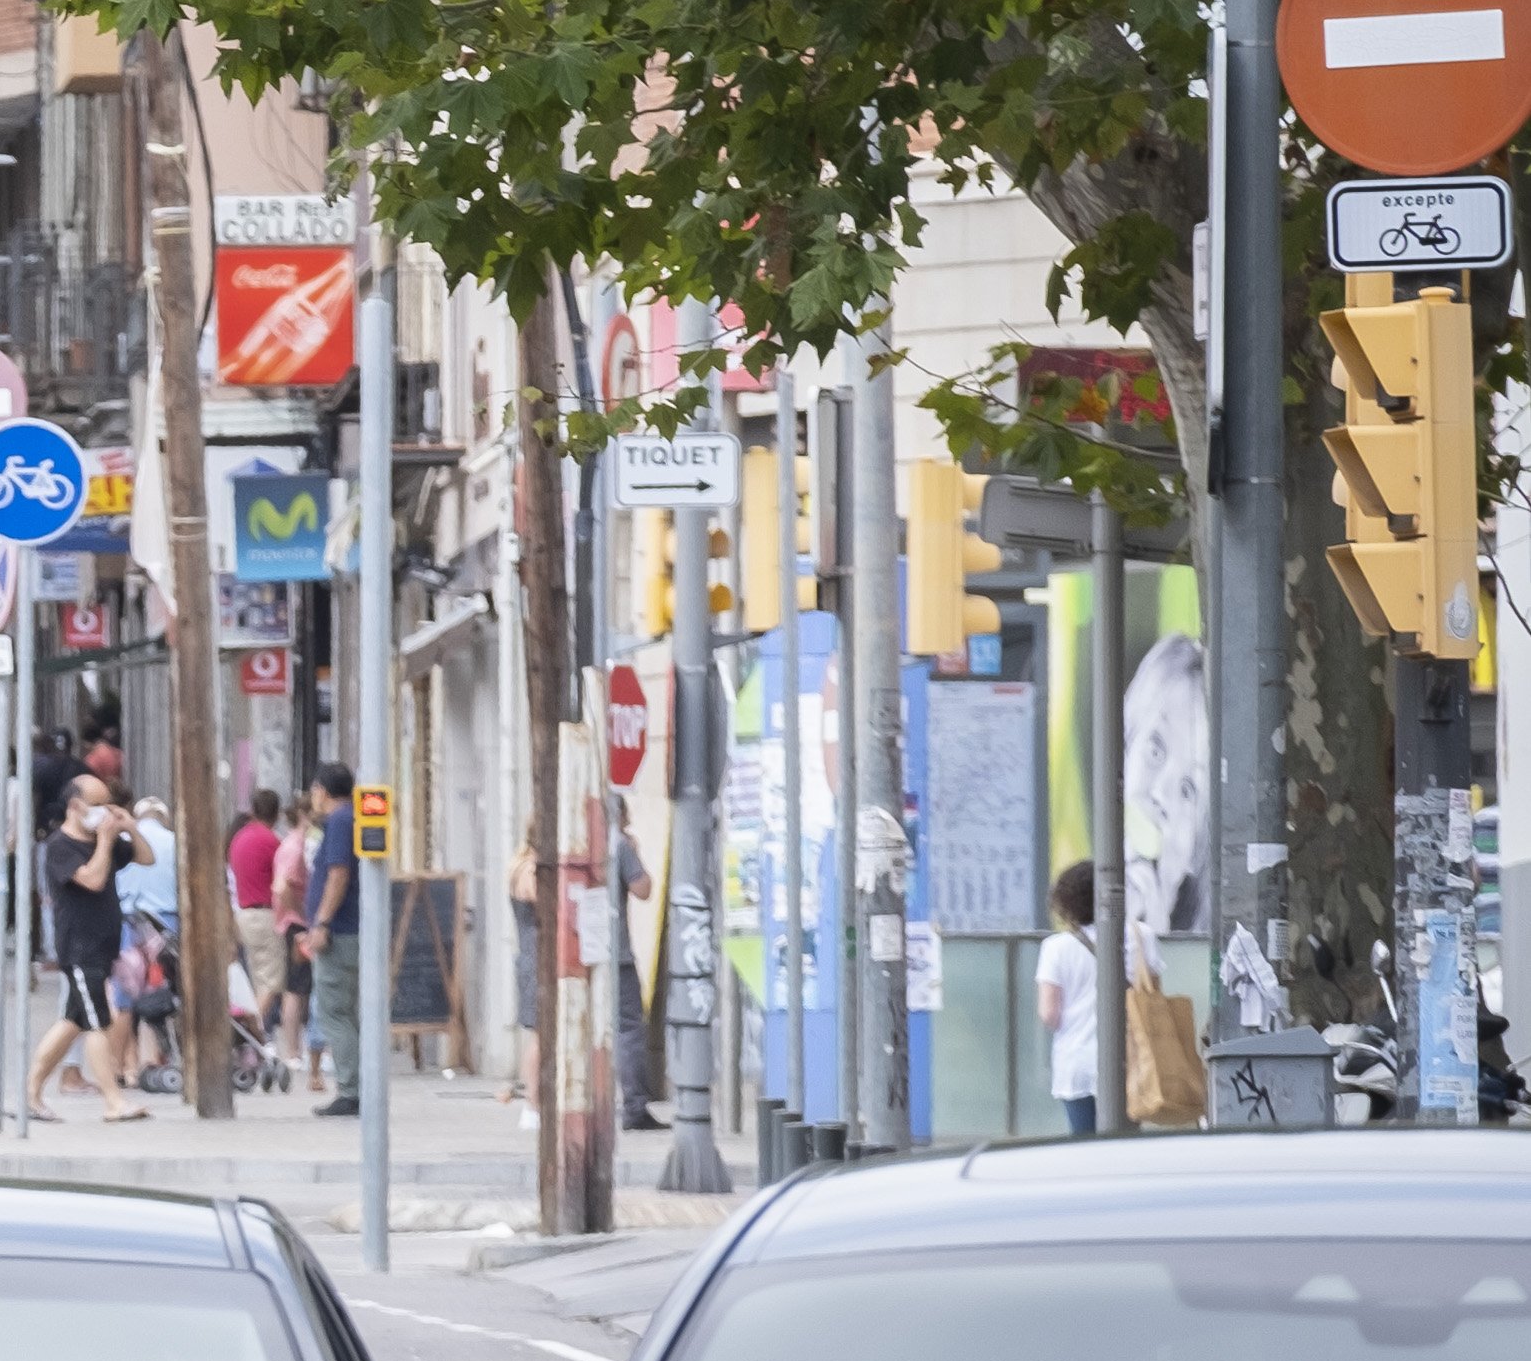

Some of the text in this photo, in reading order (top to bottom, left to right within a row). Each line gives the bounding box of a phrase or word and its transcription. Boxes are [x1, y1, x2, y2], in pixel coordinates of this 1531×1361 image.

[237, 199, 285, 217] BAR
[1382, 192, 1455, 208] excepte
[221, 218, 349, 241] COLLADO
[625, 445, 722, 466] TIQUET
